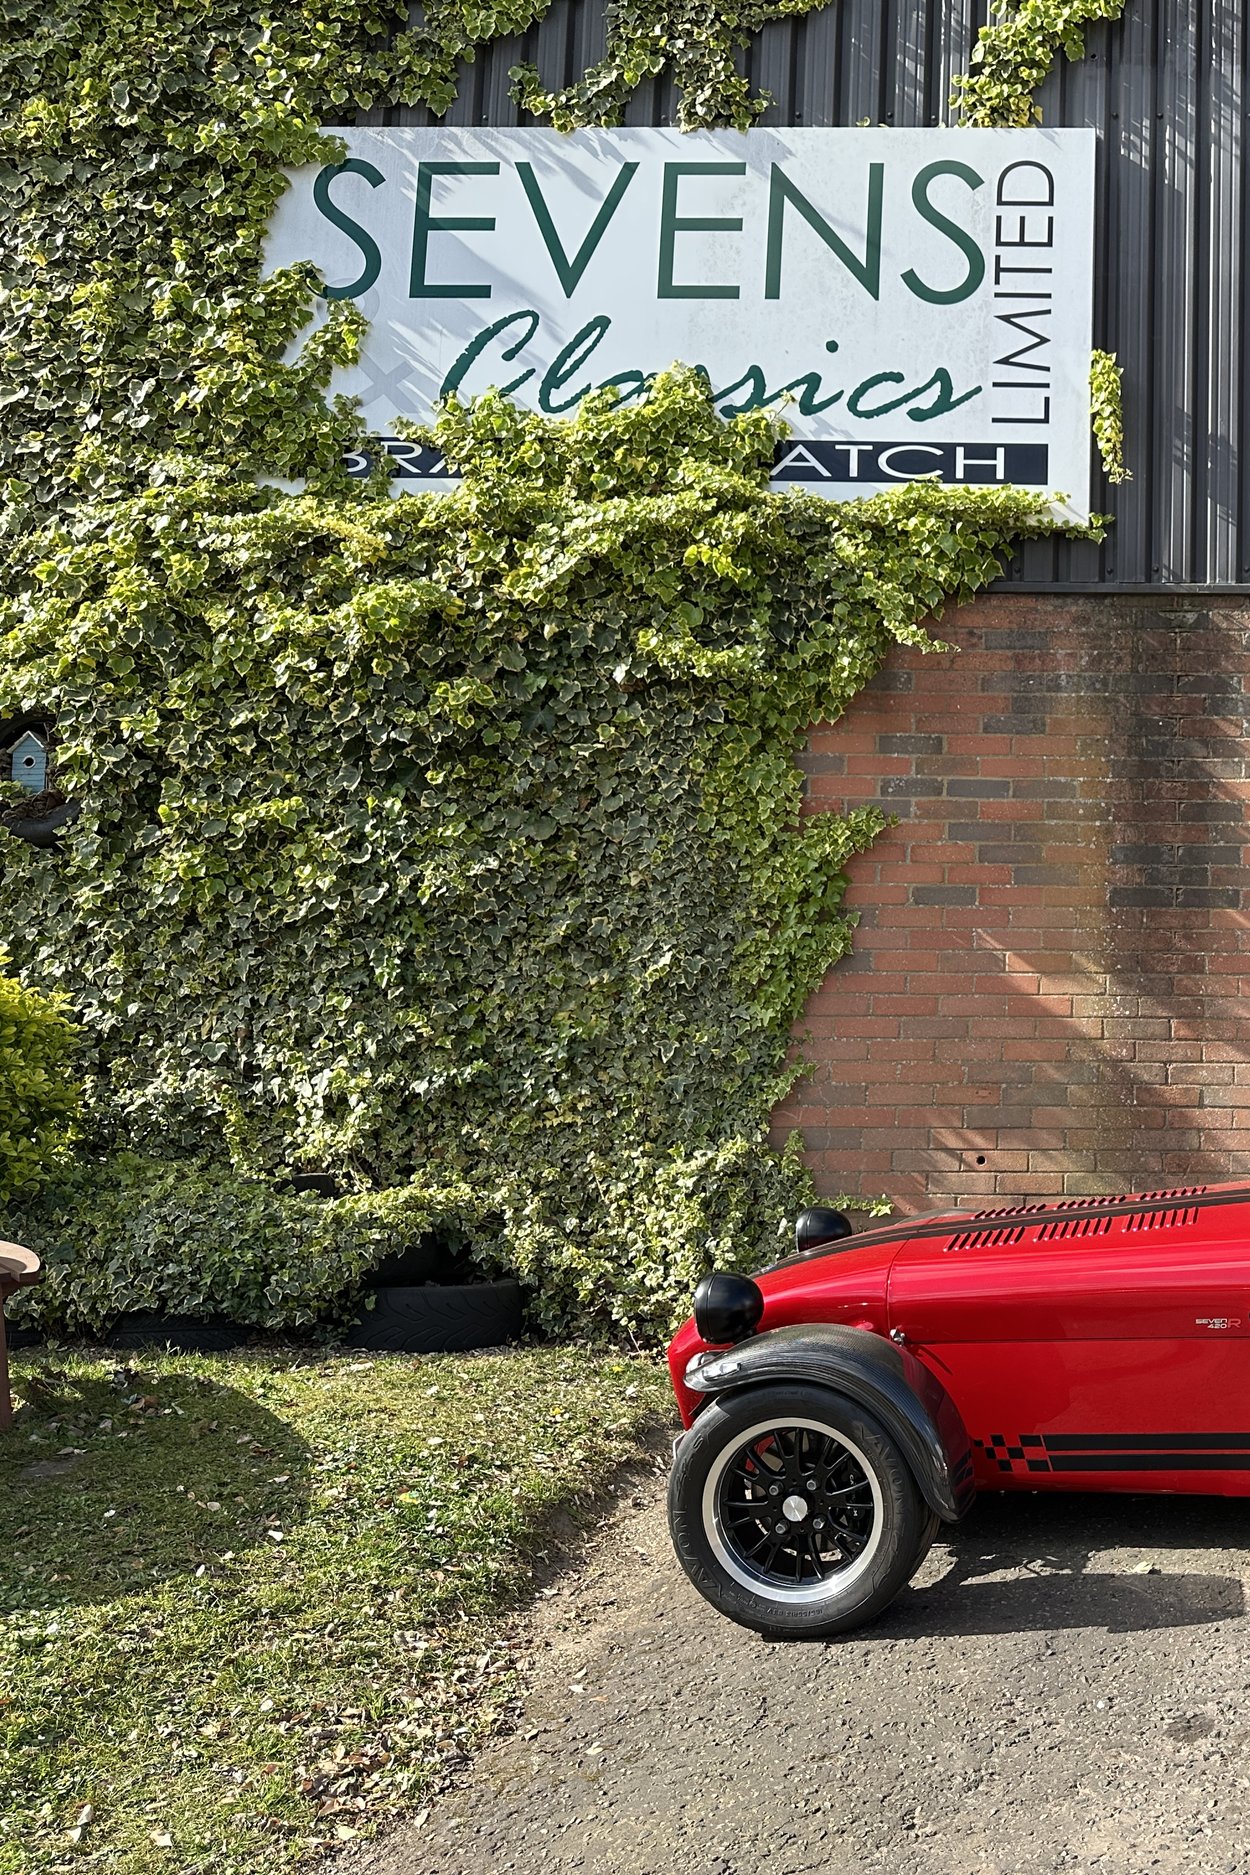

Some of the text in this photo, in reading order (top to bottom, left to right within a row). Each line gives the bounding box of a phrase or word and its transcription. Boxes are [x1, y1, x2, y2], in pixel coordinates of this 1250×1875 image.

[305, 157, 986, 306] SEVENS
[991, 160, 1054, 424] LIMITED
[769, 443, 1005, 480] ATCH
